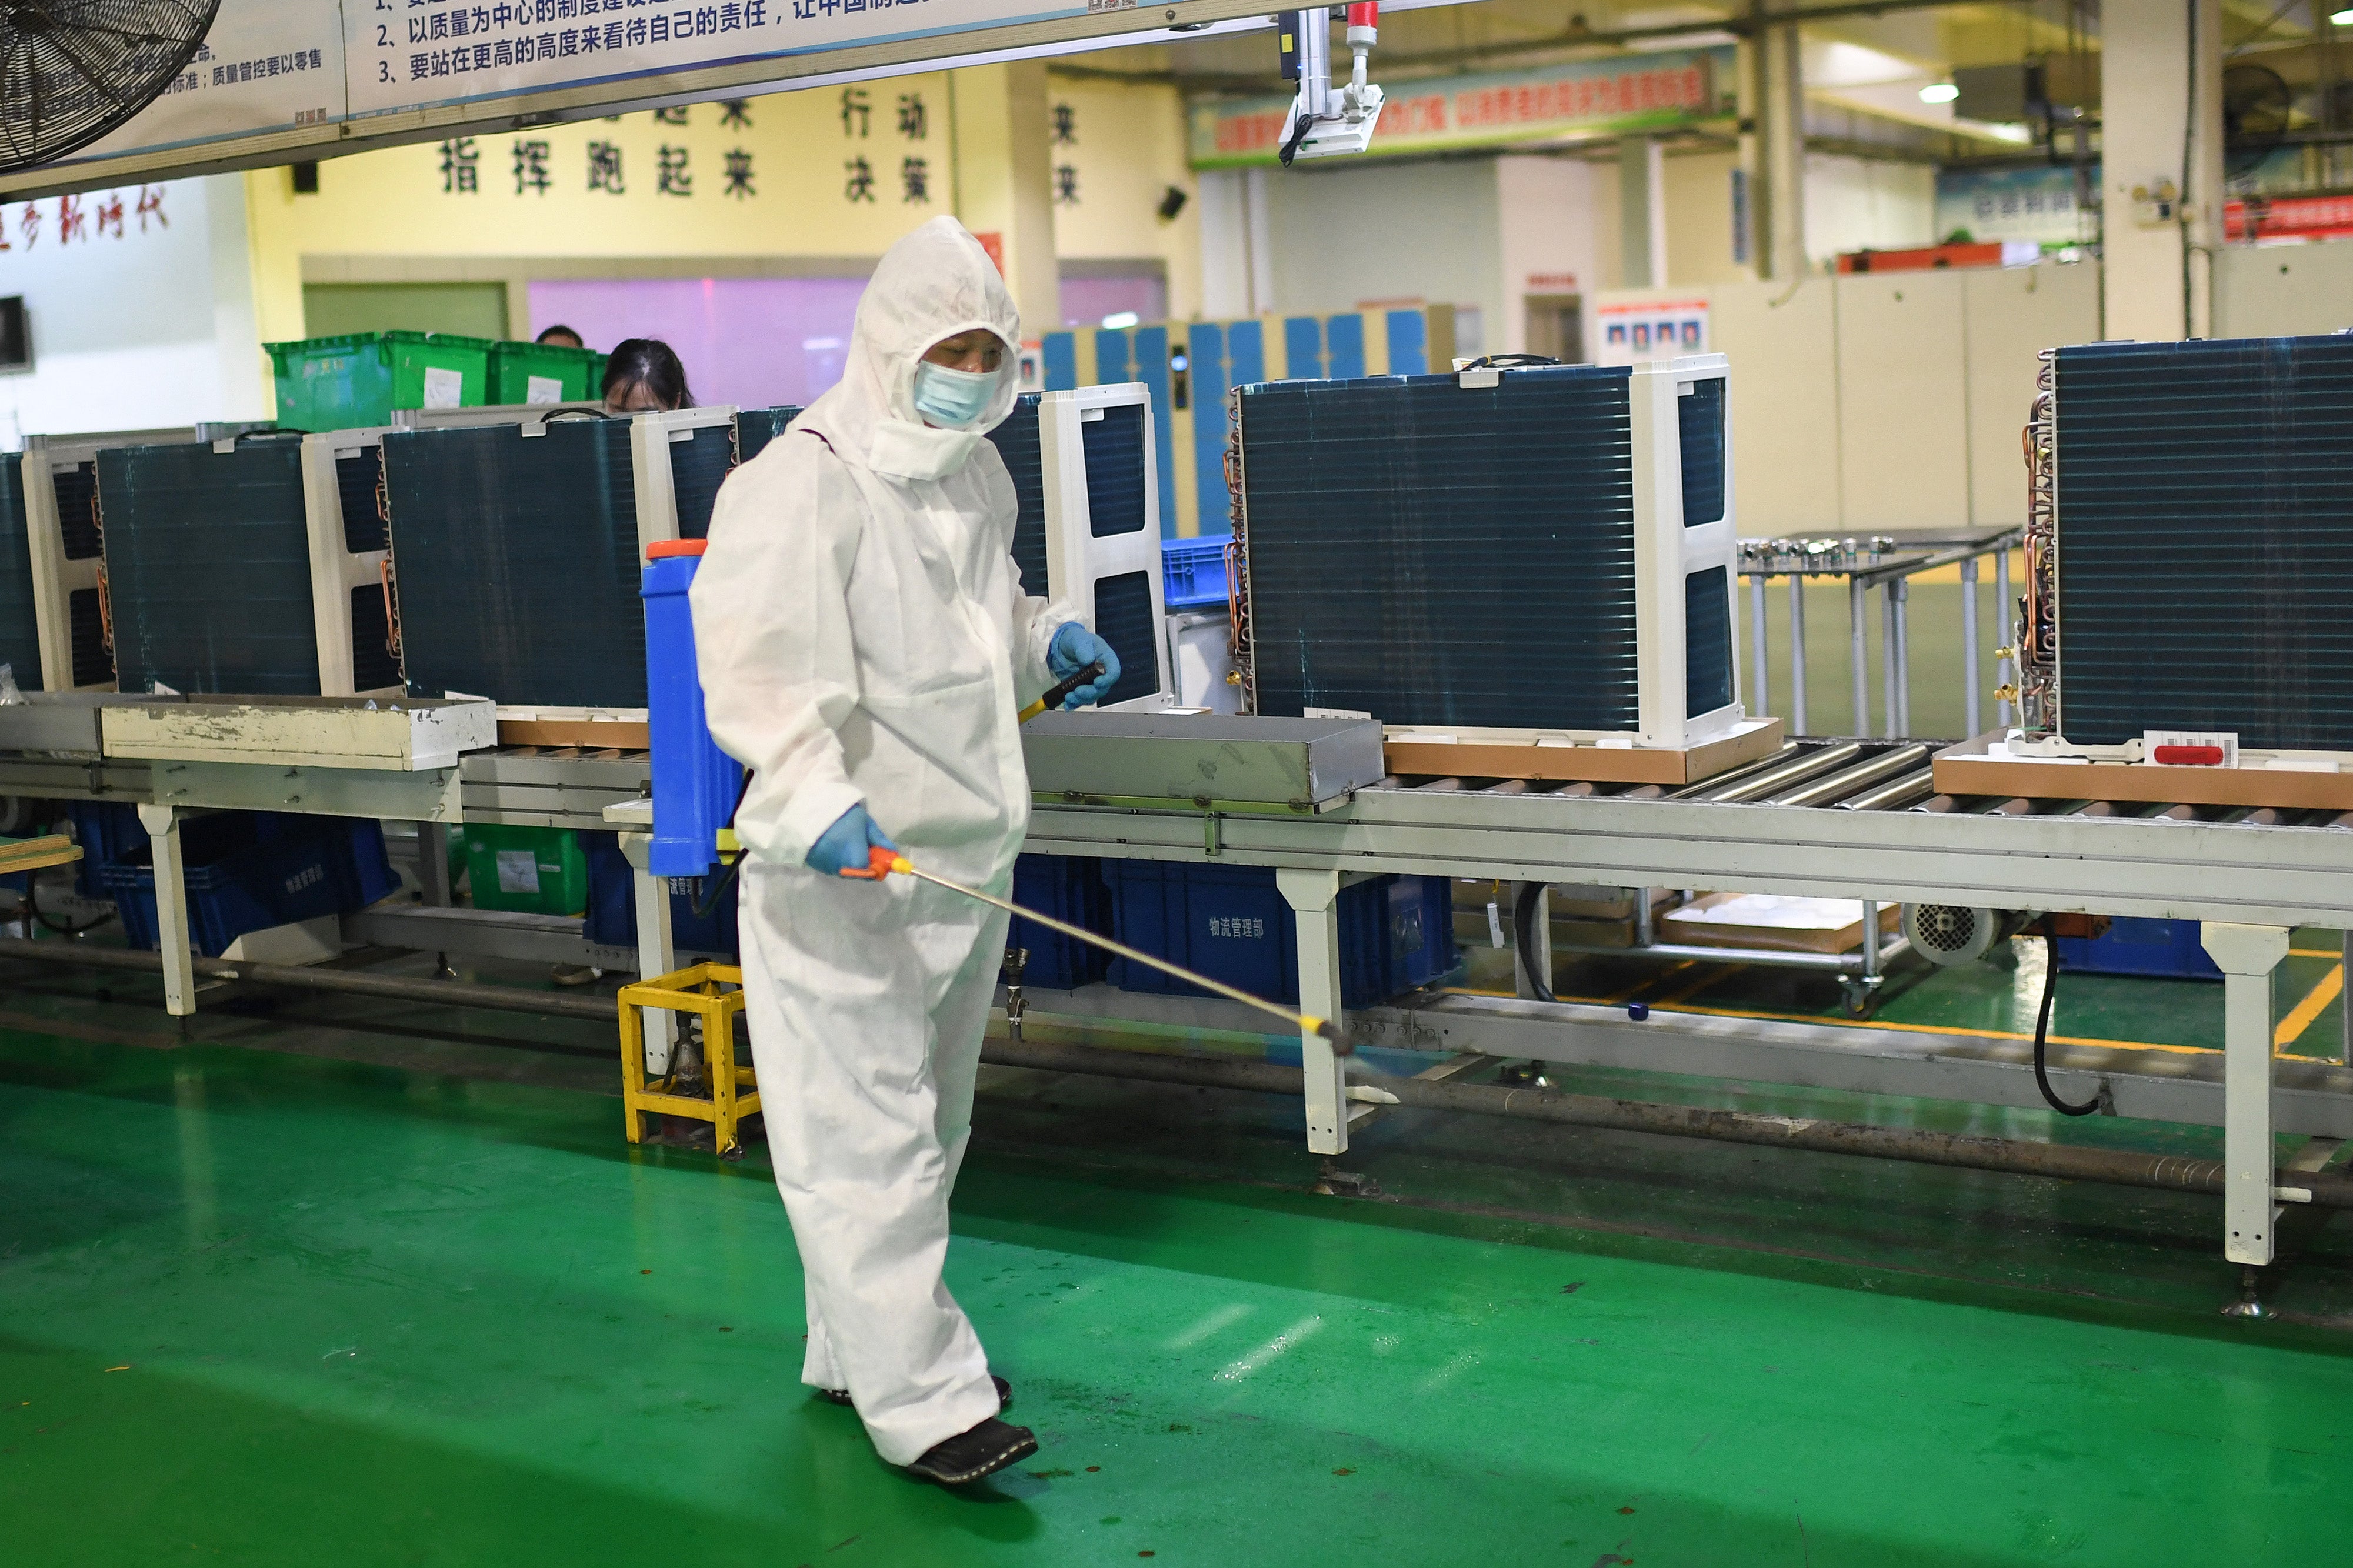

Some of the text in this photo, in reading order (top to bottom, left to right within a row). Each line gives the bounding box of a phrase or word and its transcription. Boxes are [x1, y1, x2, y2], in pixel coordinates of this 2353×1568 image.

[376, 0, 665, 48] 2、以质量为中心的制度
[378, 0, 931, 84] 3、要站在更高的高度来看待自己的责任，让中国
[439, 138, 756, 201] 指挥跑起来
[1209, 917, 1264, 939] 物流管理部
